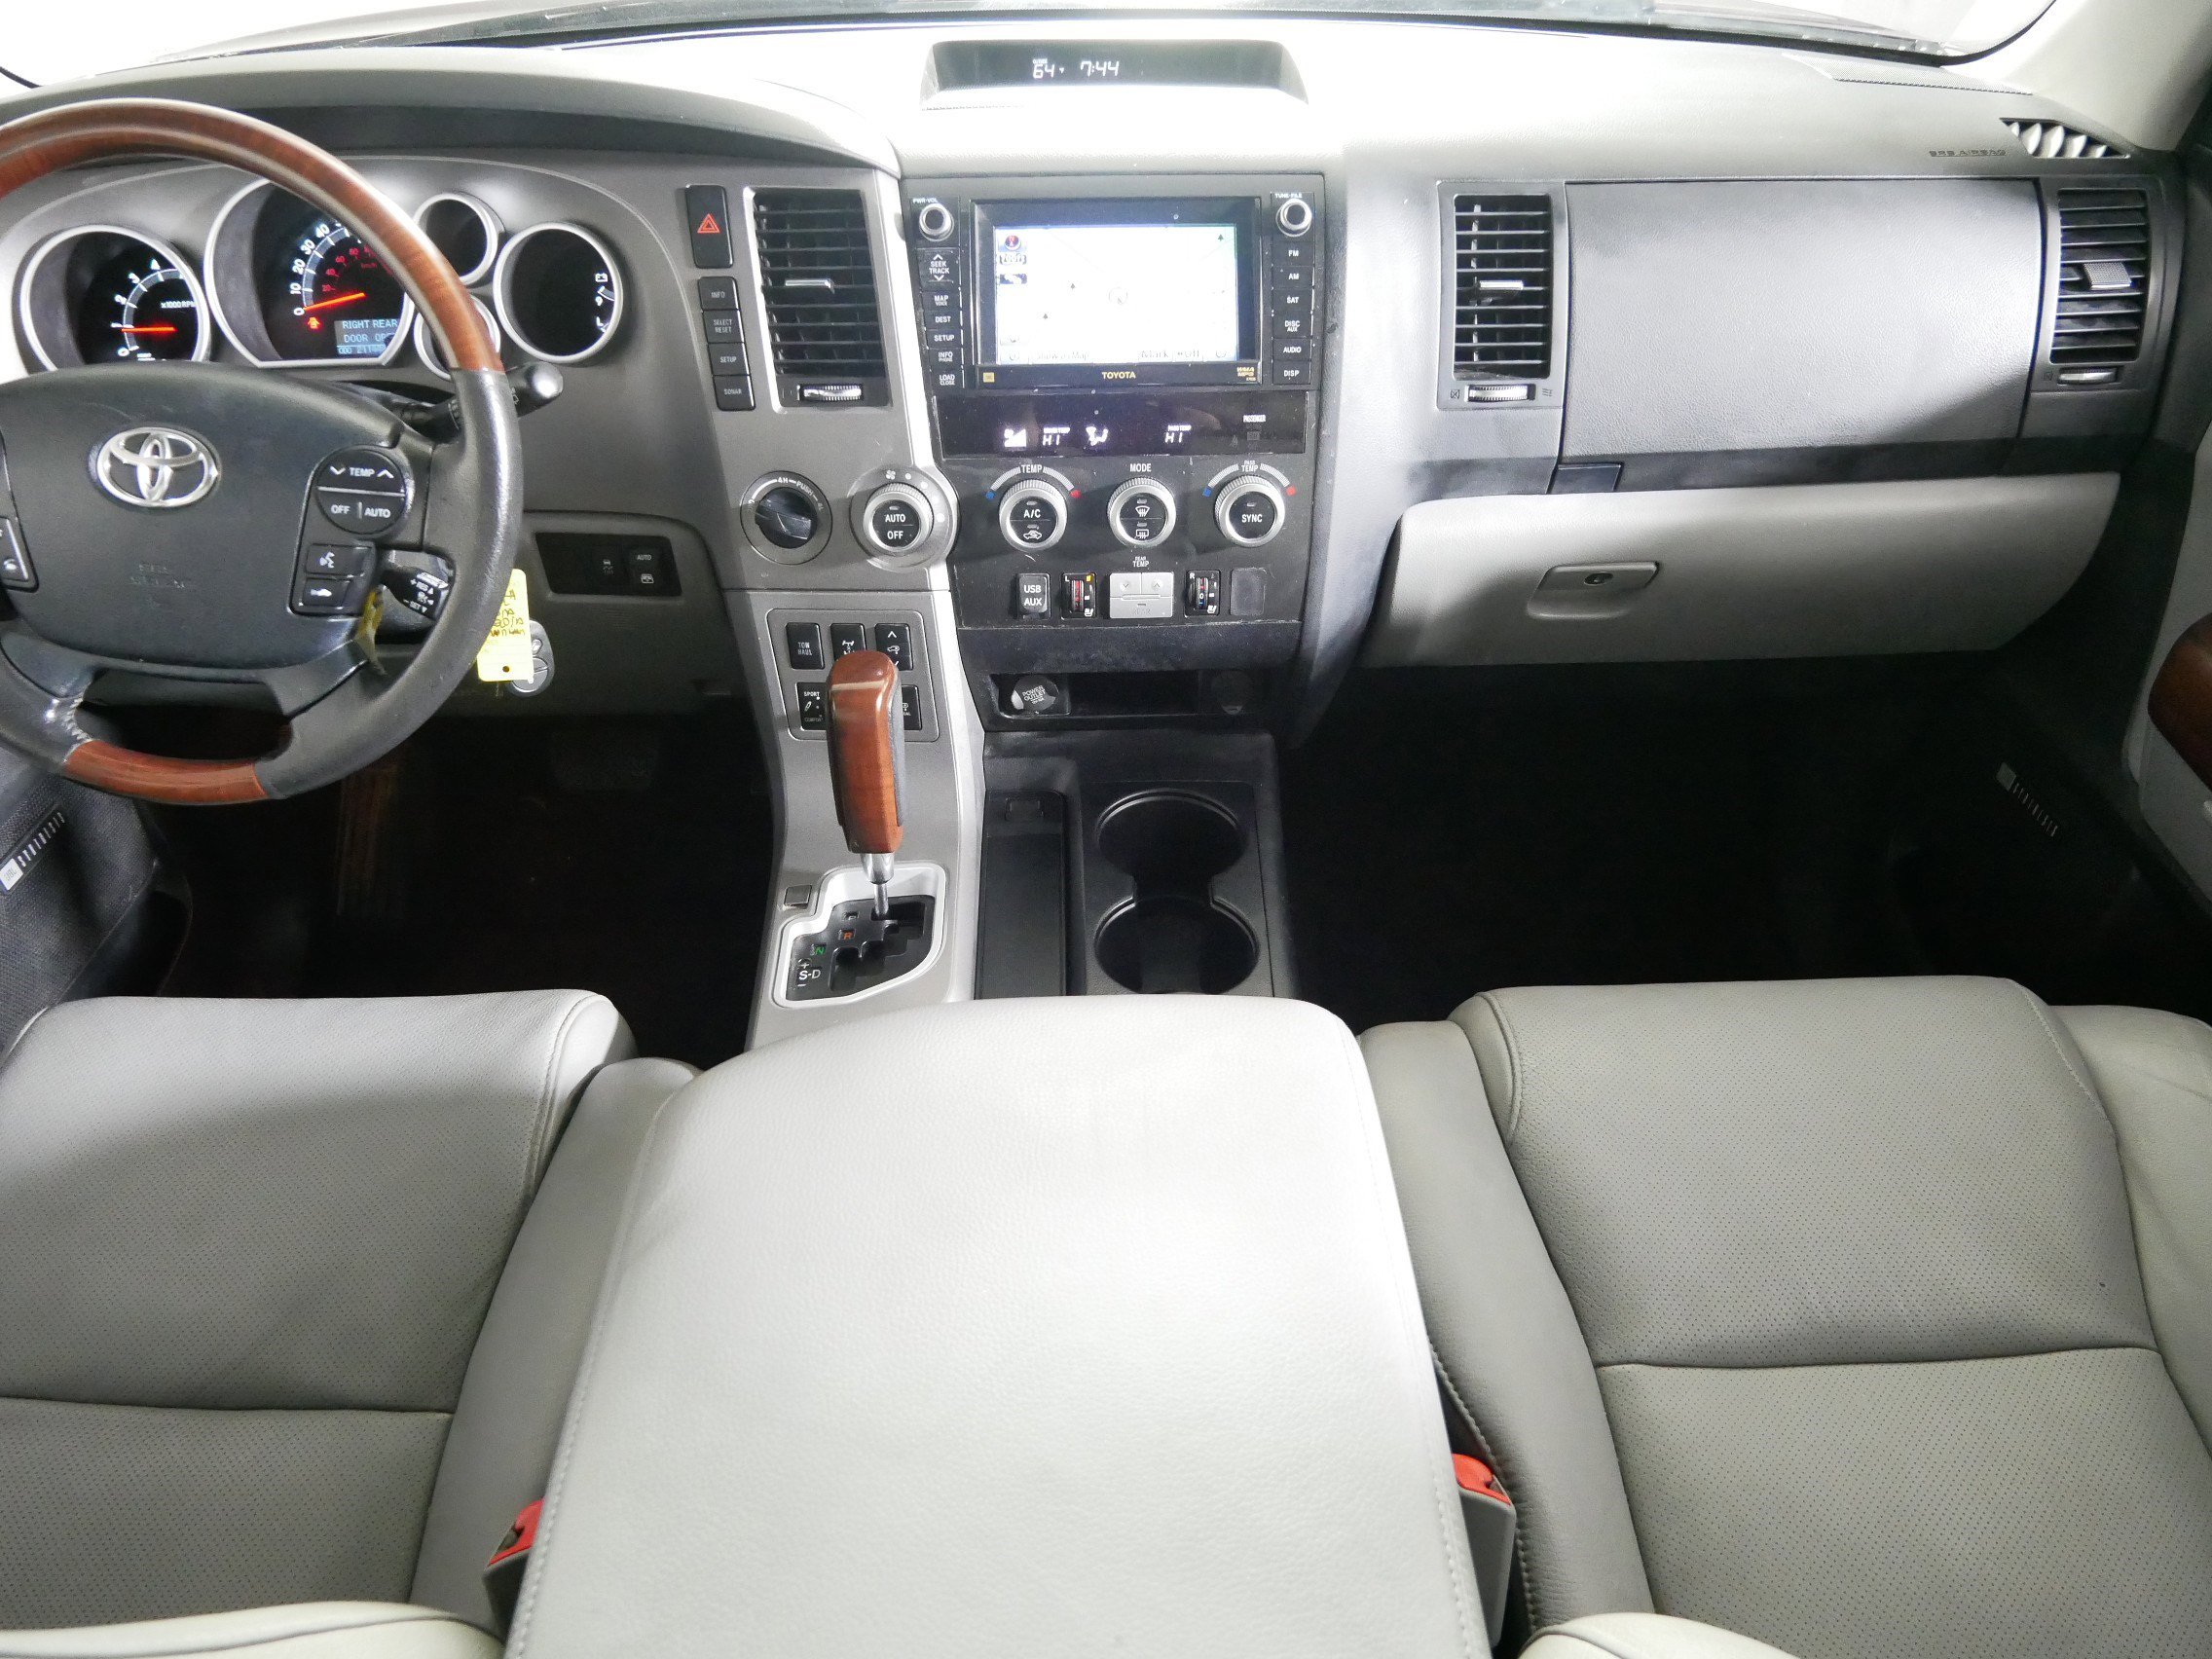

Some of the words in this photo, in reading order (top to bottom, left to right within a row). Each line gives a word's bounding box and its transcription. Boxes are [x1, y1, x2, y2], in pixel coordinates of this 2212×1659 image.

[1081, 60, 1120, 77] 7:44
[300, 239, 315, 255] 30
[293, 259, 306, 275] 20
[290, 282, 301, 295] 10
[293, 308, 305, 316] 0
[343, 320, 369, 329] RIGHT
[373, 319, 397, 328] REAR
[344, 334, 369, 343] DOOR
[1101, 371, 1136, 380] TOYOTA
[350, 467, 375, 477] TEMP
[1021, 464, 1043, 473] TEMP
[1129, 463, 1152, 472] MODE
[795, 480, 814, 496] PUSH
[331, 504, 350, 514] OFF
[364, 507, 390, 518] AUTO
[1023, 508, 1041, 518] A/C
[885, 513, 906, 523] AUTO
[1241, 514, 1263, 523] SYNC
[887, 531, 903, 539] OFF
[1023, 584, 1042, 593] USB
[1024, 597, 1043, 606] AUX
[1022, 684, 1044, 697] POWER
[1023, 688, 1046, 701] OUTLET
[843, 931, 854, 940] R
[814, 946, 826, 955] N
